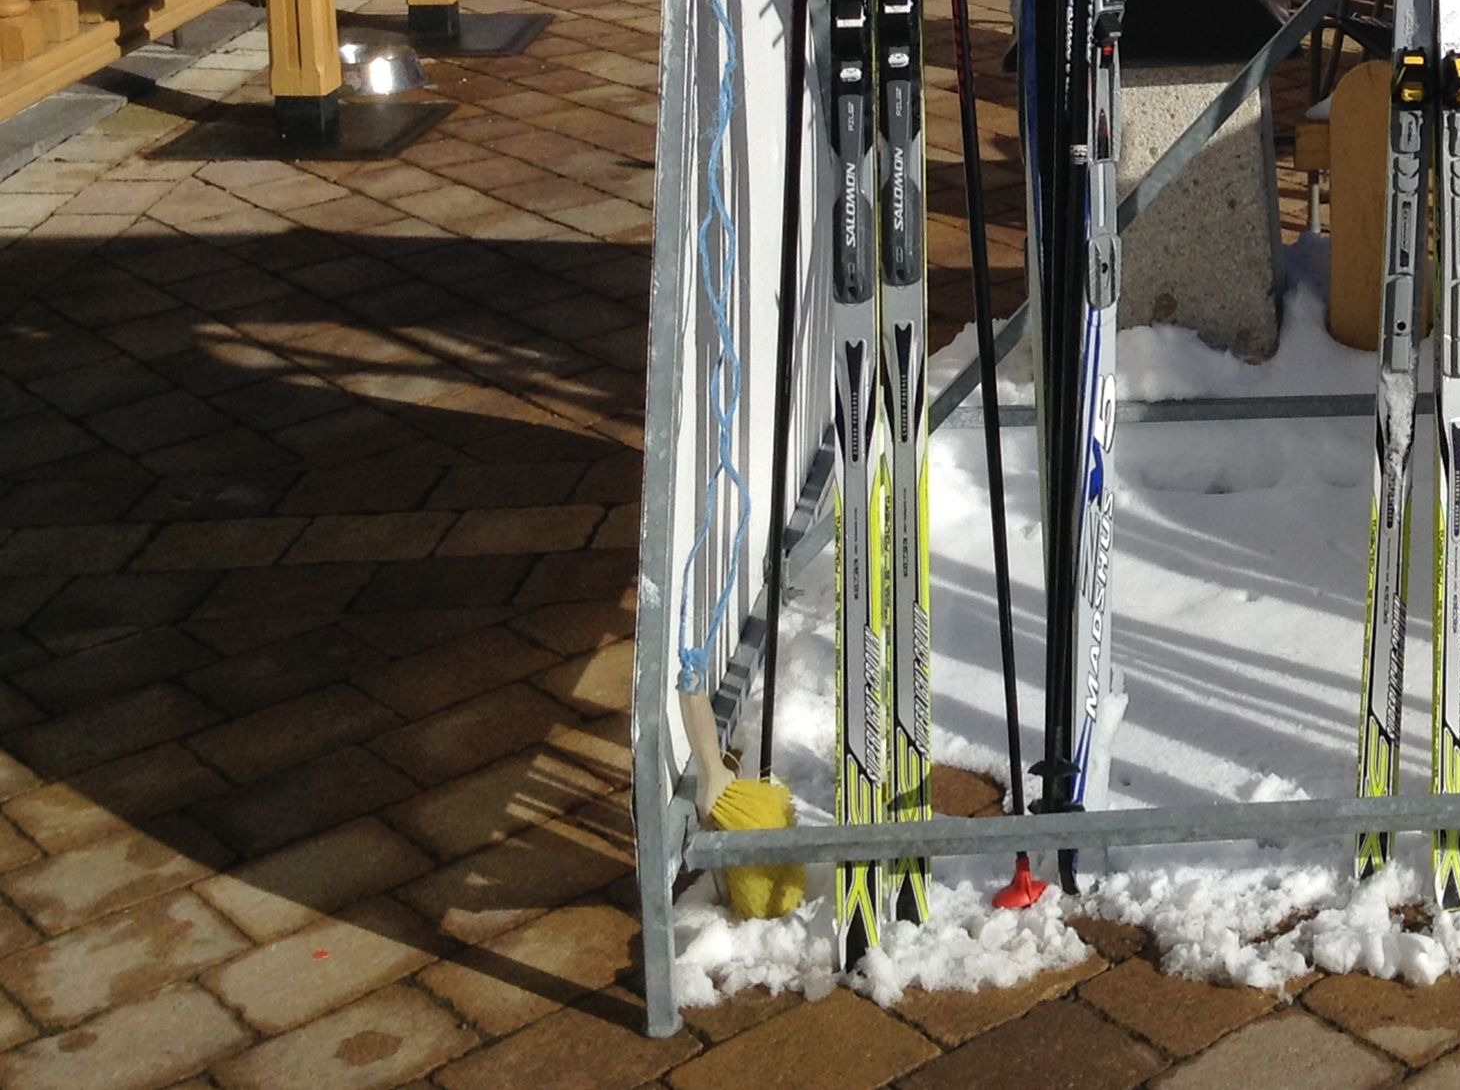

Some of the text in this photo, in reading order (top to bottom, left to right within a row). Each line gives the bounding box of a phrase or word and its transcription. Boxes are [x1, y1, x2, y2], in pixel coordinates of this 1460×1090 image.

[845, 162, 857, 248] SALOMON
[893, 147, 904, 232] SALOMON
[1083, 487, 1114, 723] MADSHUS
